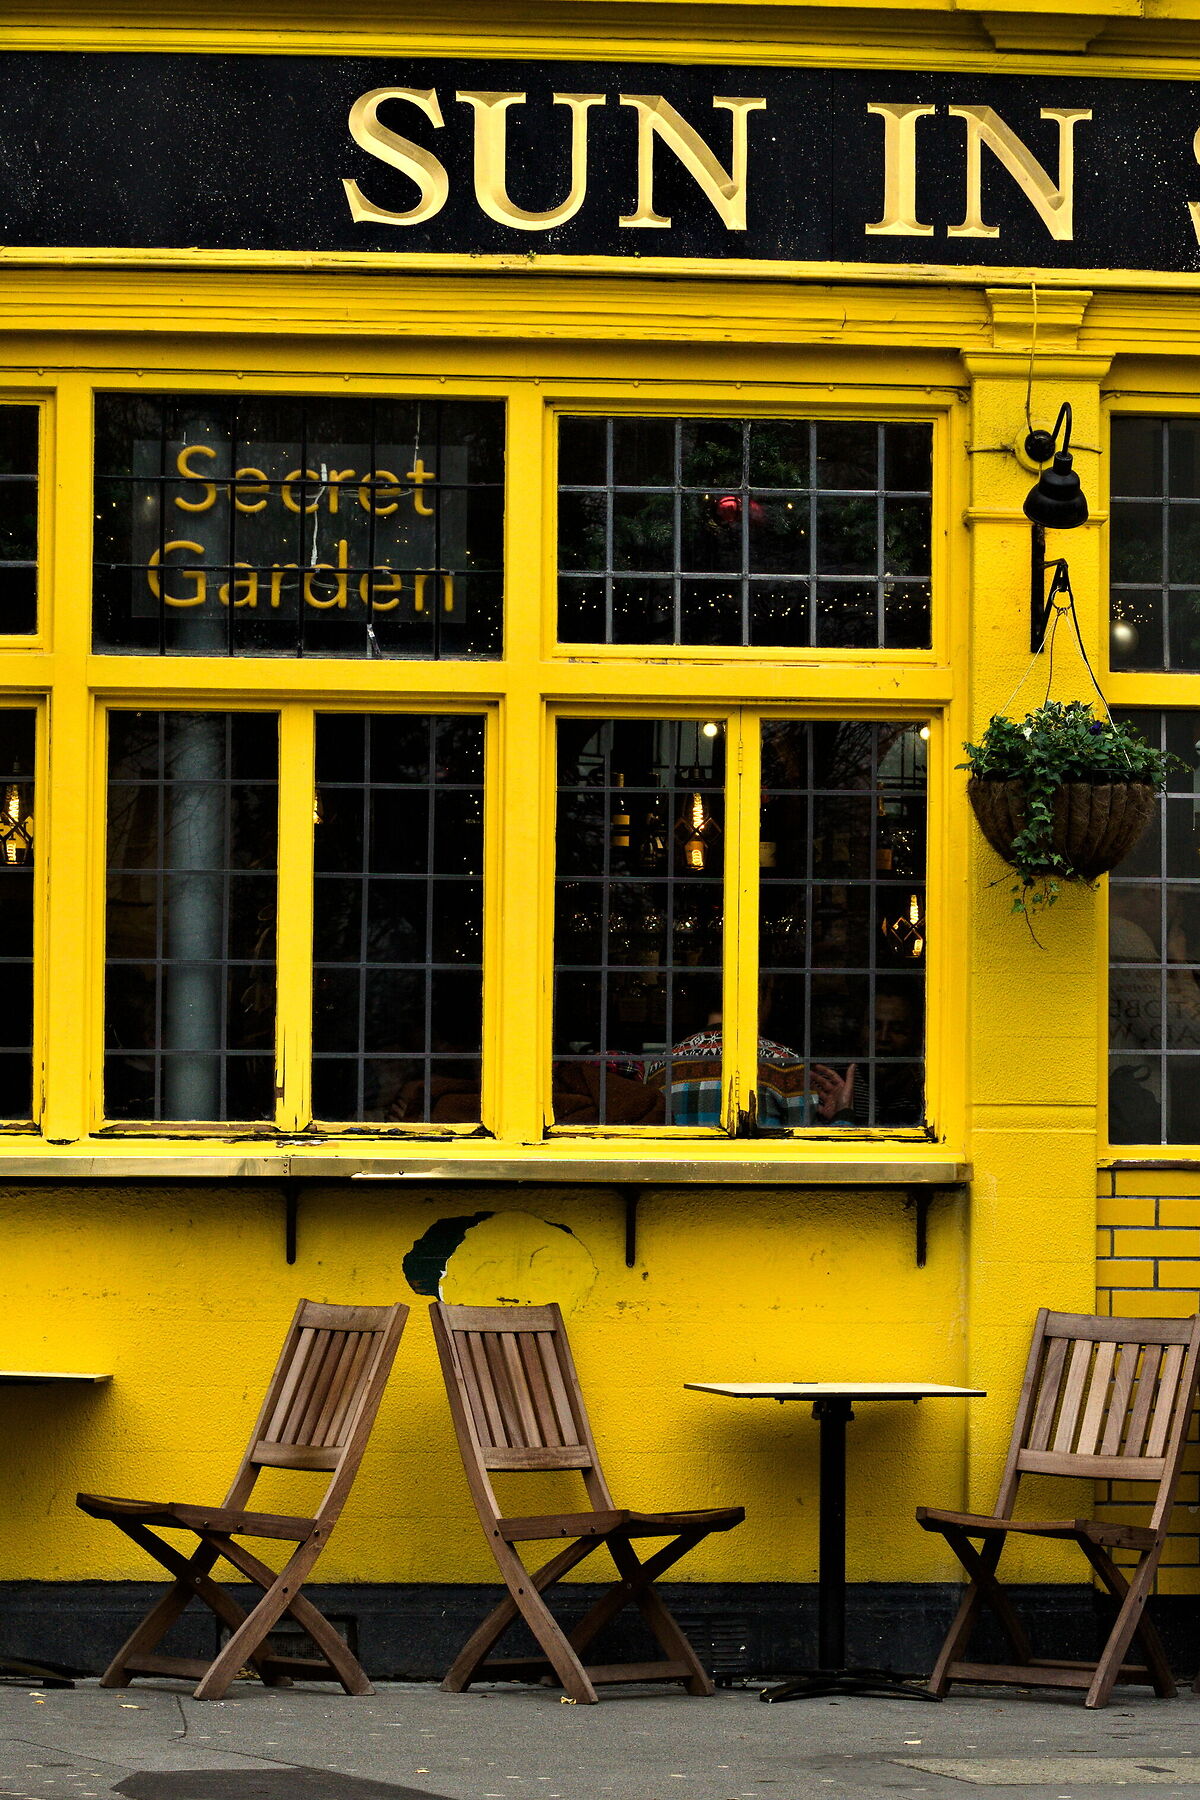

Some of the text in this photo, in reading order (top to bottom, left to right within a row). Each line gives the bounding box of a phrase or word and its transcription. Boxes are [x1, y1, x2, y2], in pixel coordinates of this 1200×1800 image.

[341, 86, 767, 232] SUN
[864, 102, 1093, 241] IN
[174, 444, 436, 517] Secret
[147, 539, 454, 613] Garden
